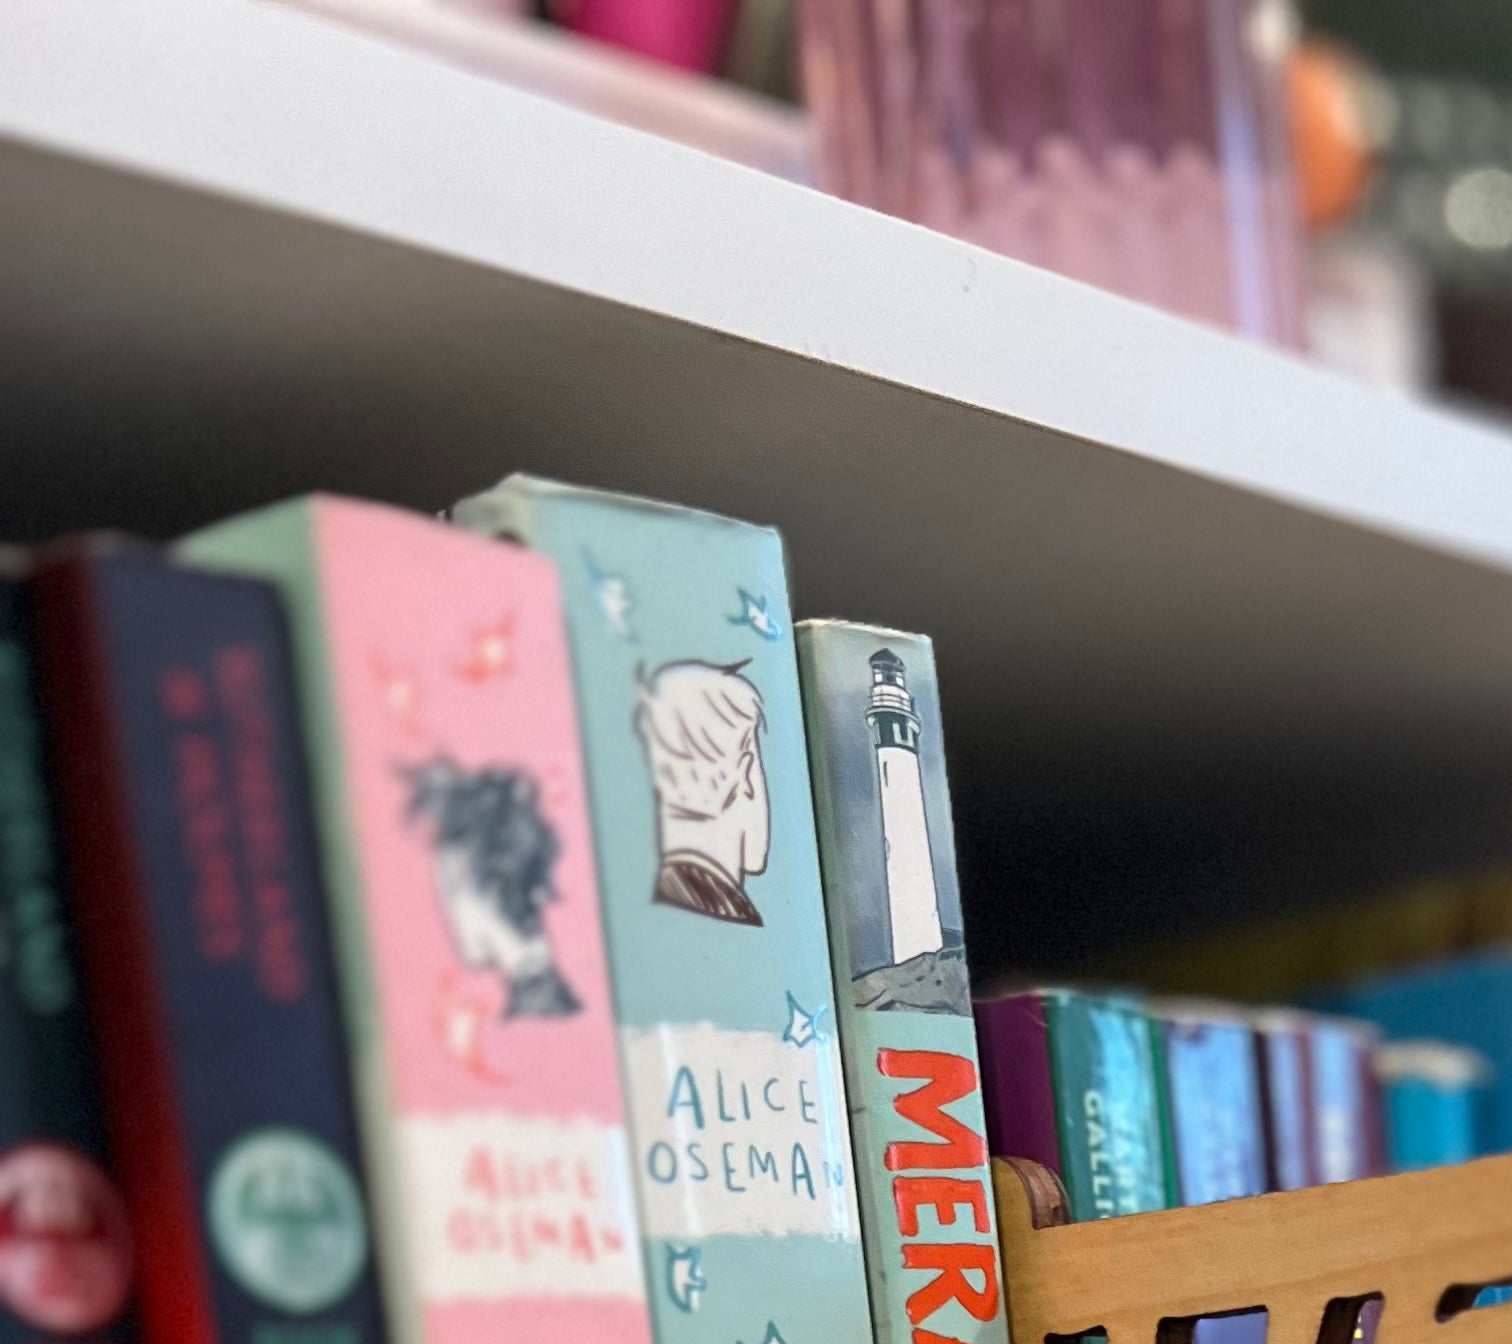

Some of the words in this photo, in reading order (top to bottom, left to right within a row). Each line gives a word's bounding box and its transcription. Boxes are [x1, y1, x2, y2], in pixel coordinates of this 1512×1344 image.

[667, 1065, 819, 1130] ALICE
[462, 1145, 597, 1202] ALICE
[647, 1141, 844, 1200] OSEMAN
[446, 1207, 624, 1264] OSEMAN
